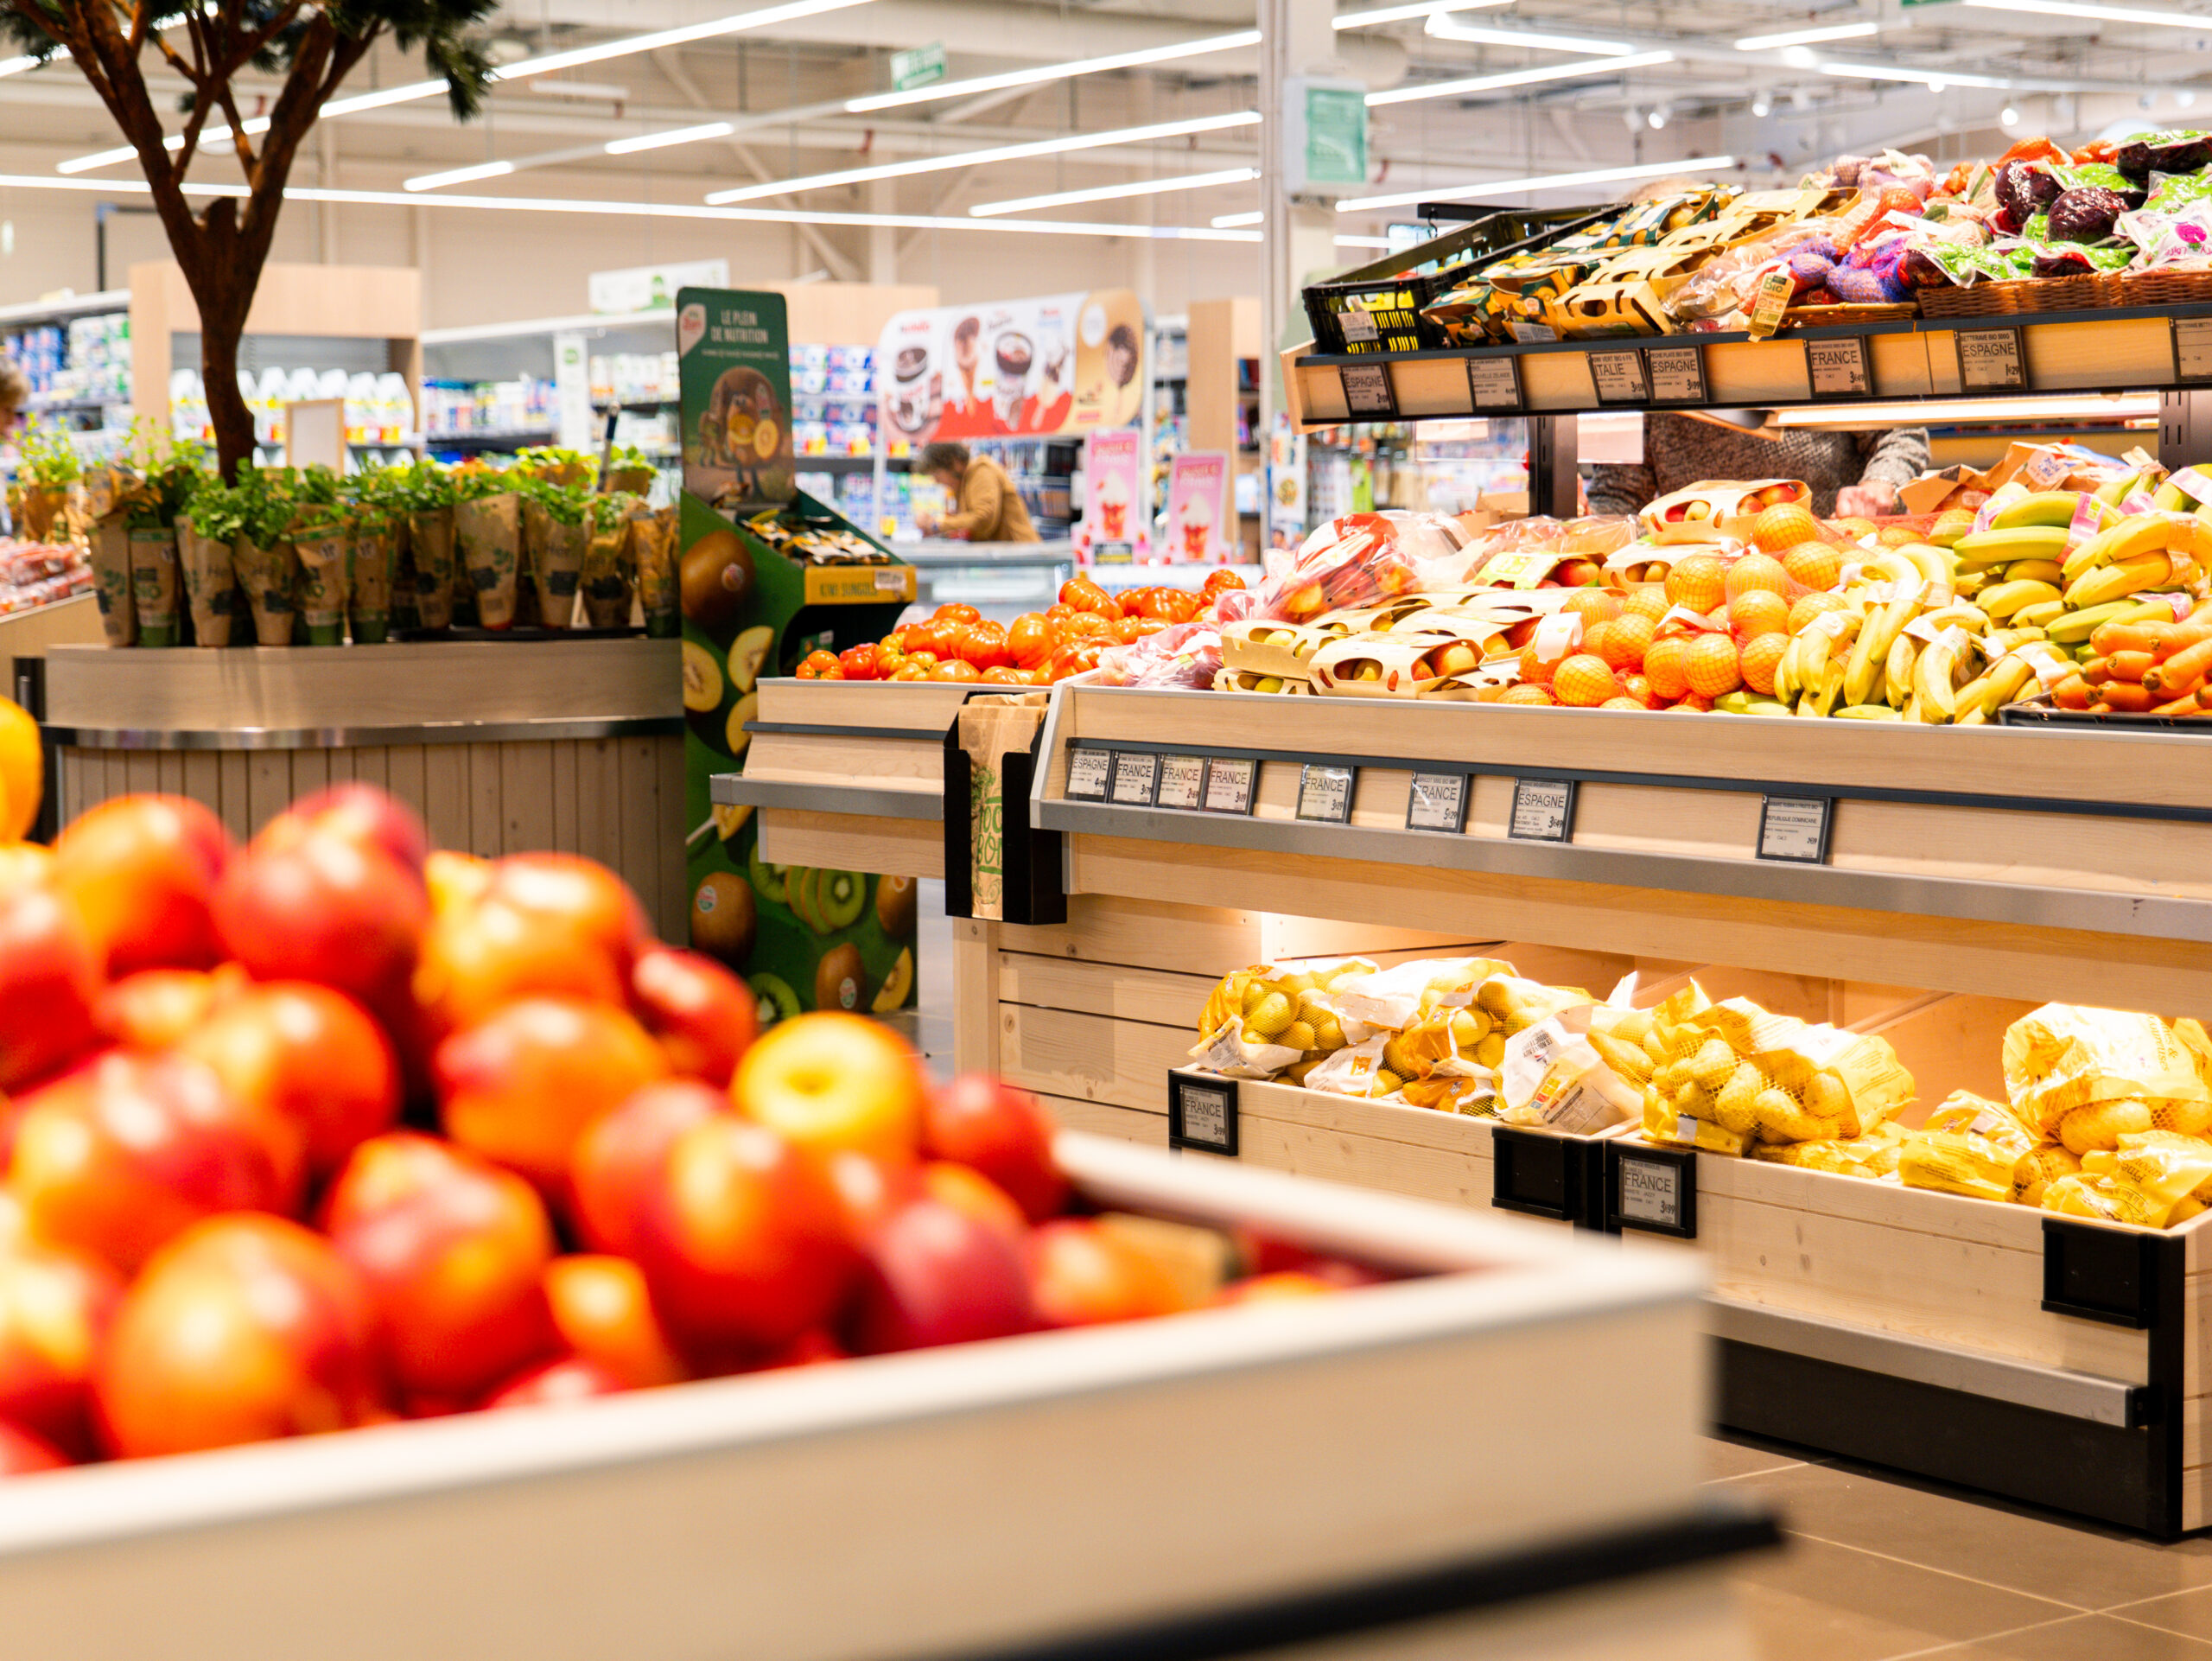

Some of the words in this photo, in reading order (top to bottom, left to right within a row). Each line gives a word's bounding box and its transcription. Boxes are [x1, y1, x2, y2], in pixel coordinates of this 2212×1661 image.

[1962, 342, 2015, 357] ESPAGNE
[1811, 350, 1859, 365] FRANCE
[1594, 363, 1625, 376] ITALIE
[1652, 360, 1696, 372] ESPAGNE
[1346, 375, 1383, 389] ESPAGNE
[1073, 758, 1107, 771] ESPAGNE
[1117, 763, 1152, 778] FRANCE
[1163, 767, 1199, 781] FRANCE
[1211, 770, 1247, 785] FRANCE
[1304, 777, 1344, 792] FRANCE
[1518, 793, 1565, 808] ESPAGNE
[1185, 1099, 1222, 1117] FRANCE
[1624, 1172, 1672, 1193] FRANCE
